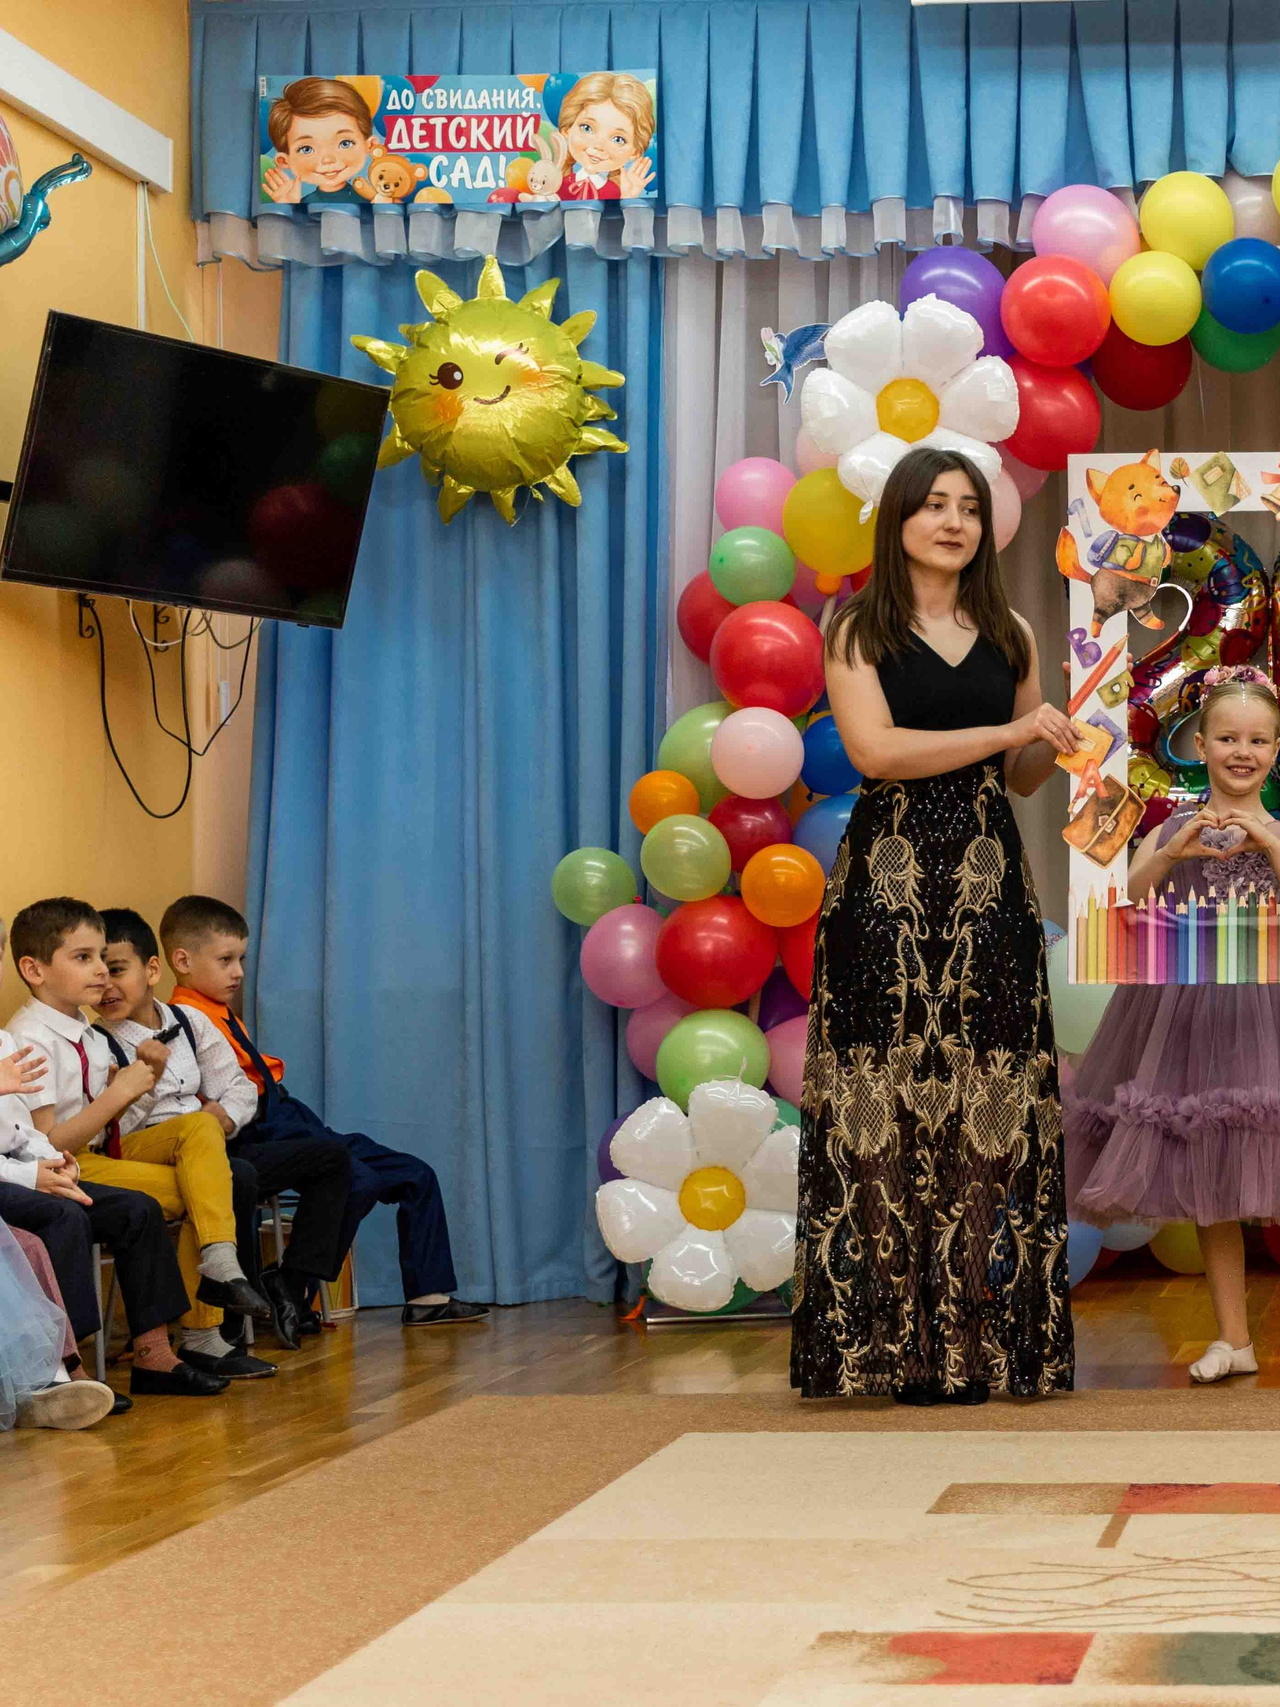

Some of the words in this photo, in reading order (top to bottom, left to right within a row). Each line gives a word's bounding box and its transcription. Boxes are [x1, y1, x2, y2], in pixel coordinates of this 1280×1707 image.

[387, 89, 414, 110] ДО
[421, 87, 542, 110] СВИДАНИЯ,
[387, 112, 536, 150] ДЕТСКИЙ
[428, 154, 507, 189] САД!
